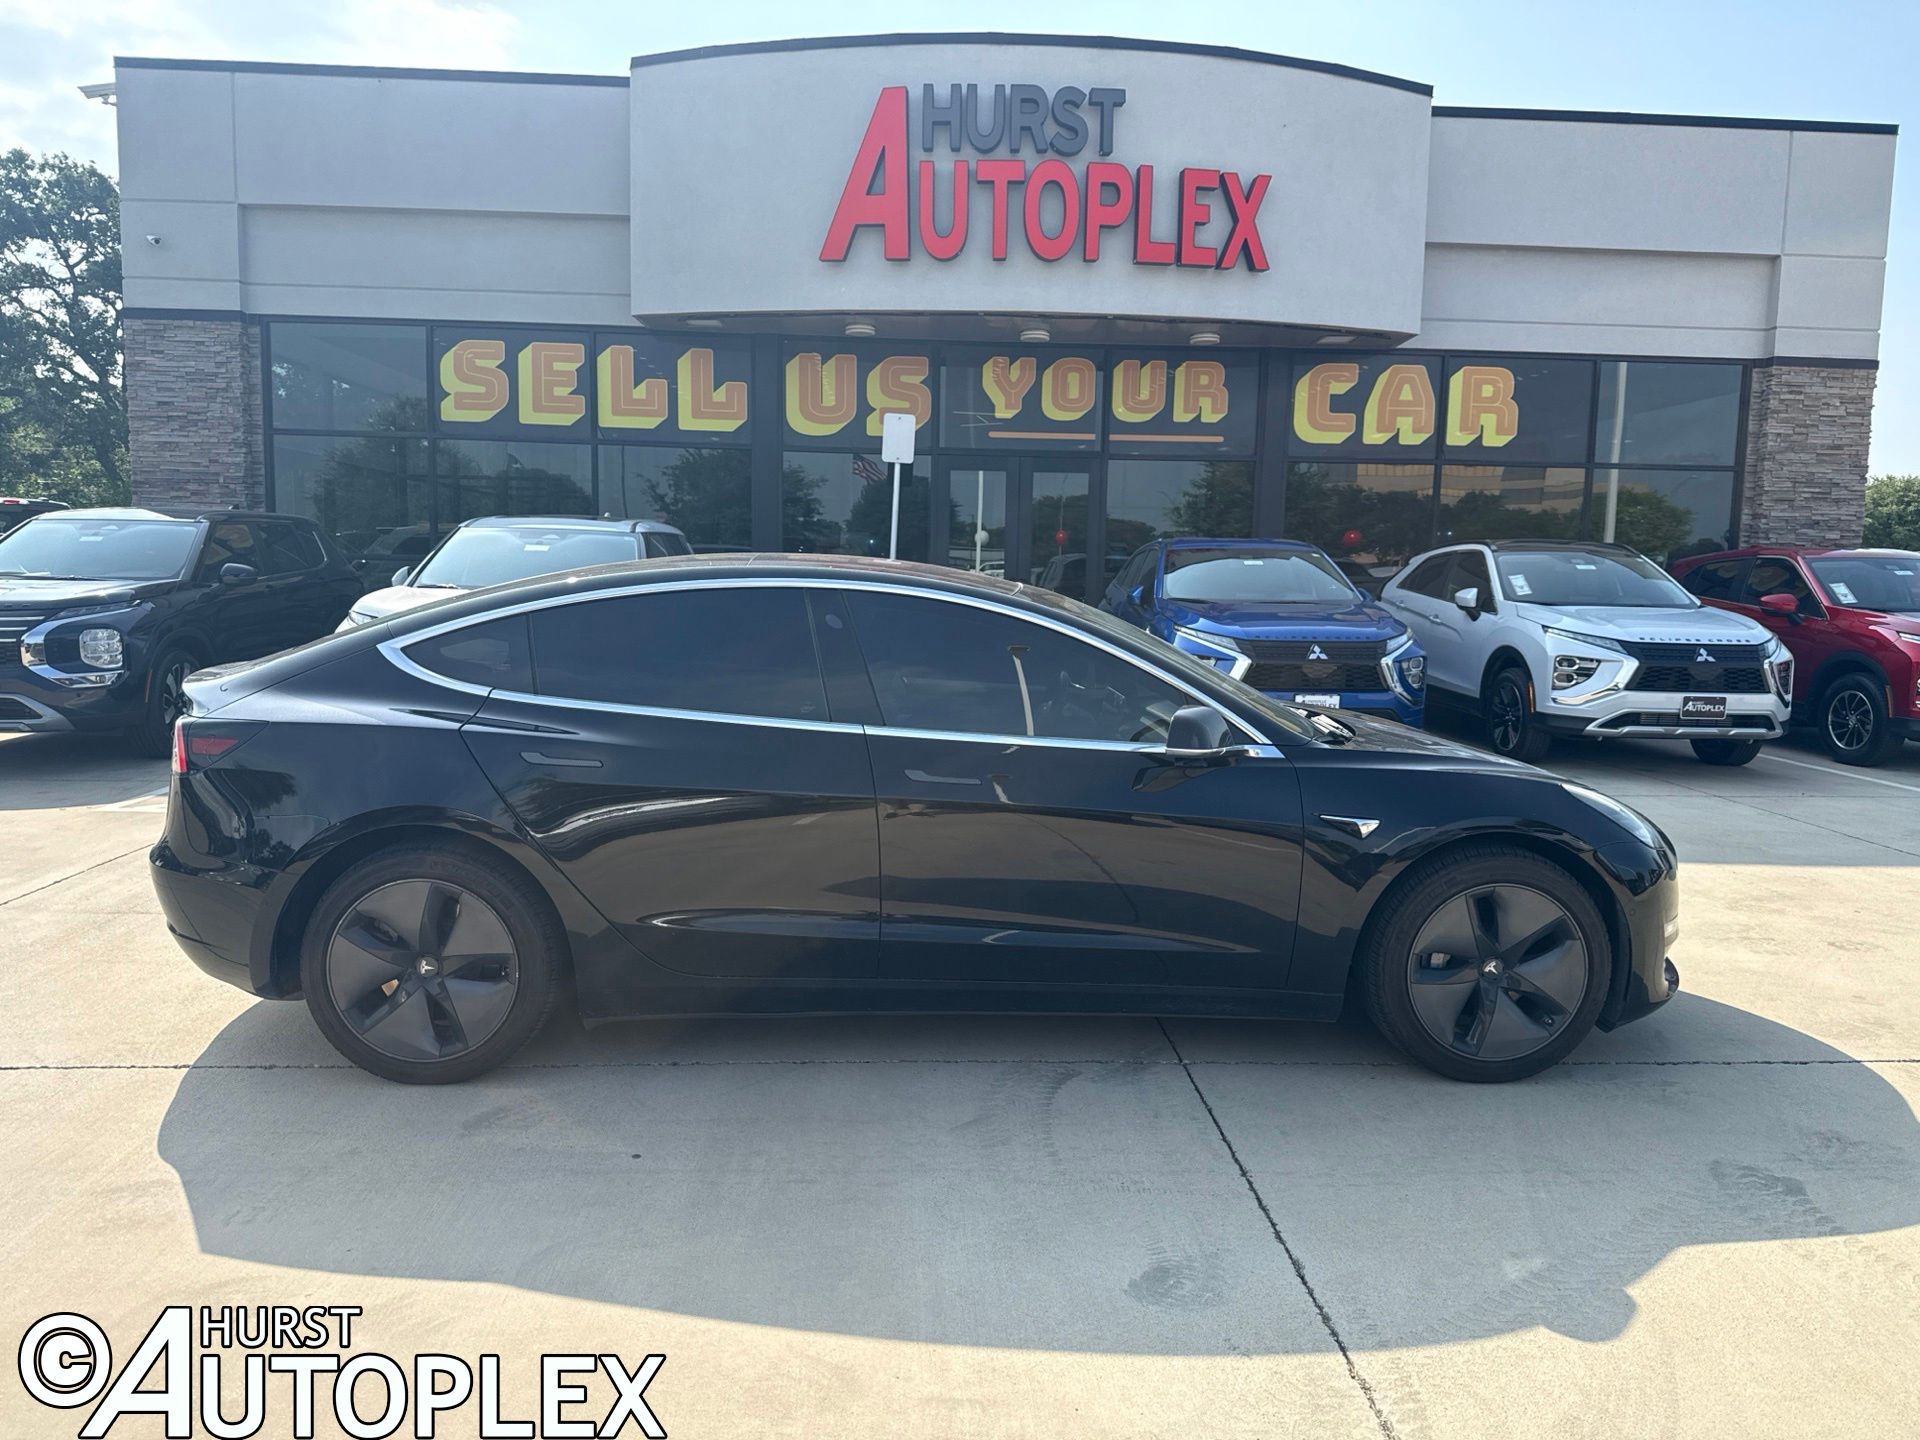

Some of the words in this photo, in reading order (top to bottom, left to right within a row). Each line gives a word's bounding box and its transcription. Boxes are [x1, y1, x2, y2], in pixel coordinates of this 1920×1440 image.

[922, 83, 1126, 156] HURST
[819, 86, 1272, 272] AUTOPLEX
[440, 339, 748, 432] SELL
[786, 352, 932, 436] US
[982, 356, 1229, 423] YOUR
[1293, 363, 1518, 447] CAR
[1683, 701, 1725, 712] AUTOPLEX
